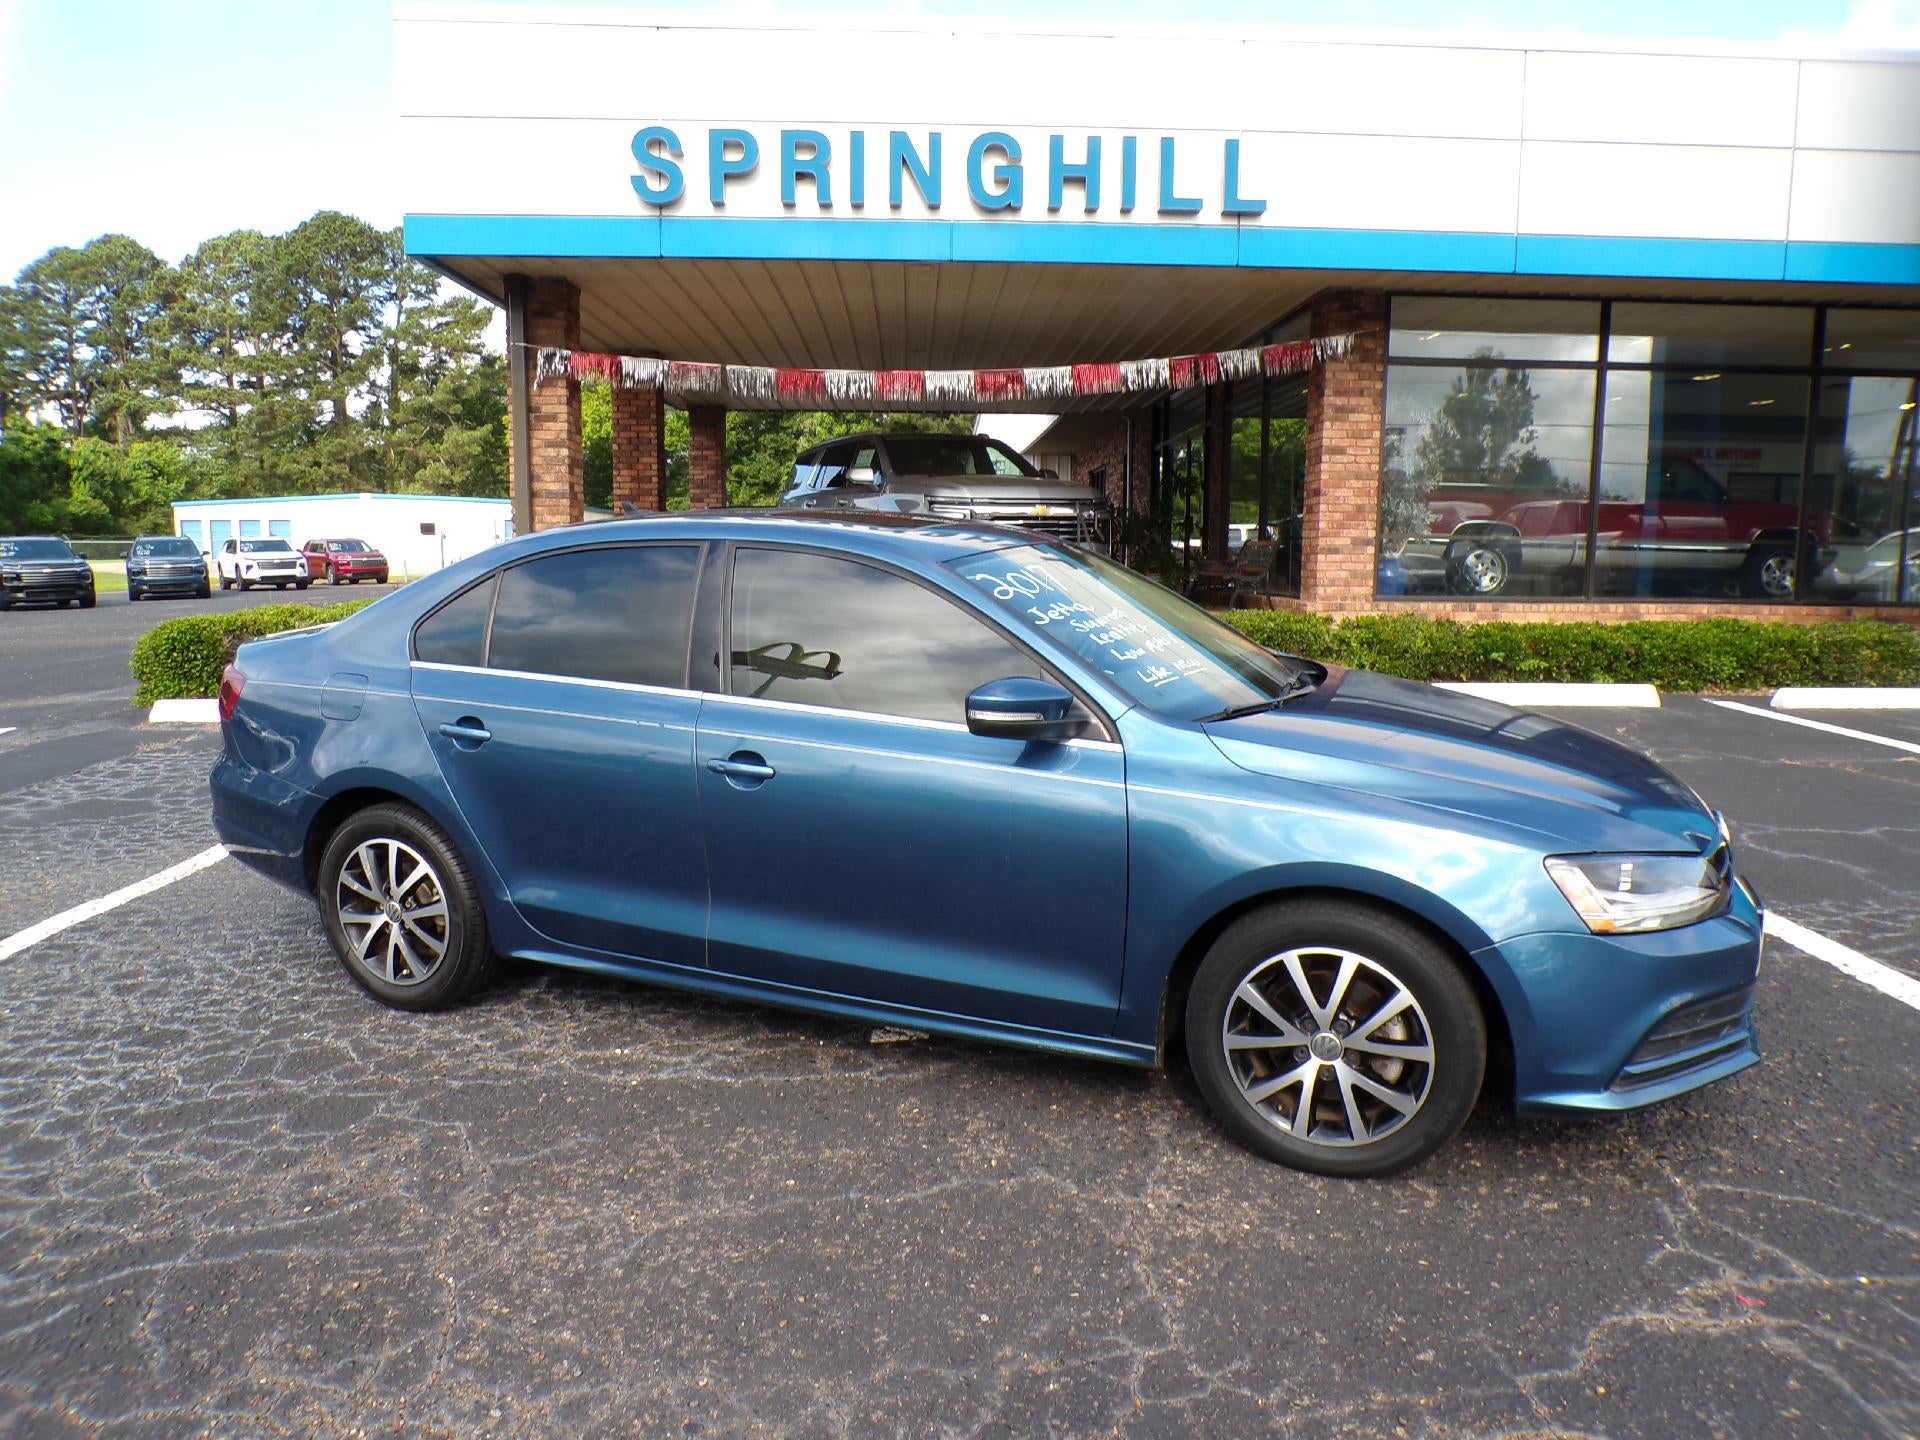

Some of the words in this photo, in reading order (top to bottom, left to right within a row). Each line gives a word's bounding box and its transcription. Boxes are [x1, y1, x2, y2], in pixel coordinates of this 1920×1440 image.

[630, 125, 1268, 217] SPRINGHILL
[975, 564, 1069, 600] 2017
[1027, 601, 1095, 626] Jetta
